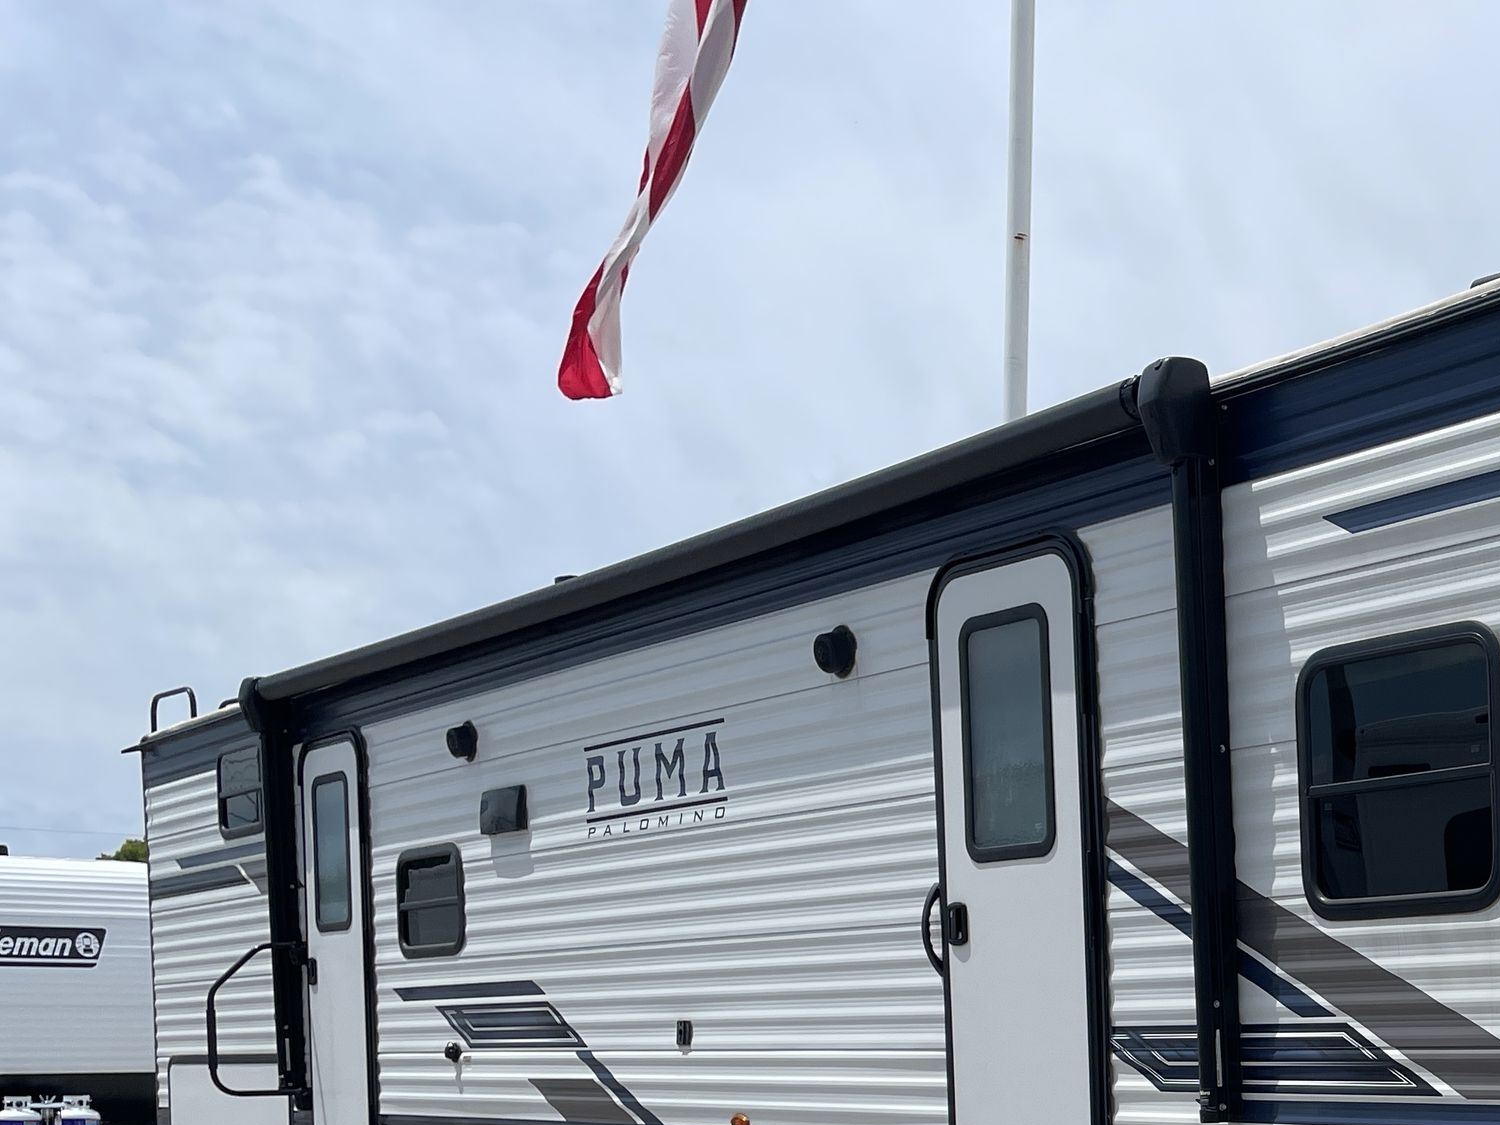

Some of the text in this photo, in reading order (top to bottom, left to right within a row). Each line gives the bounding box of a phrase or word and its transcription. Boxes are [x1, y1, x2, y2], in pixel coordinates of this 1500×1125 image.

[586, 731, 726, 813] PUMA
[588, 806, 726, 839] PALOMINO
[0, 936, 72, 957] eman
